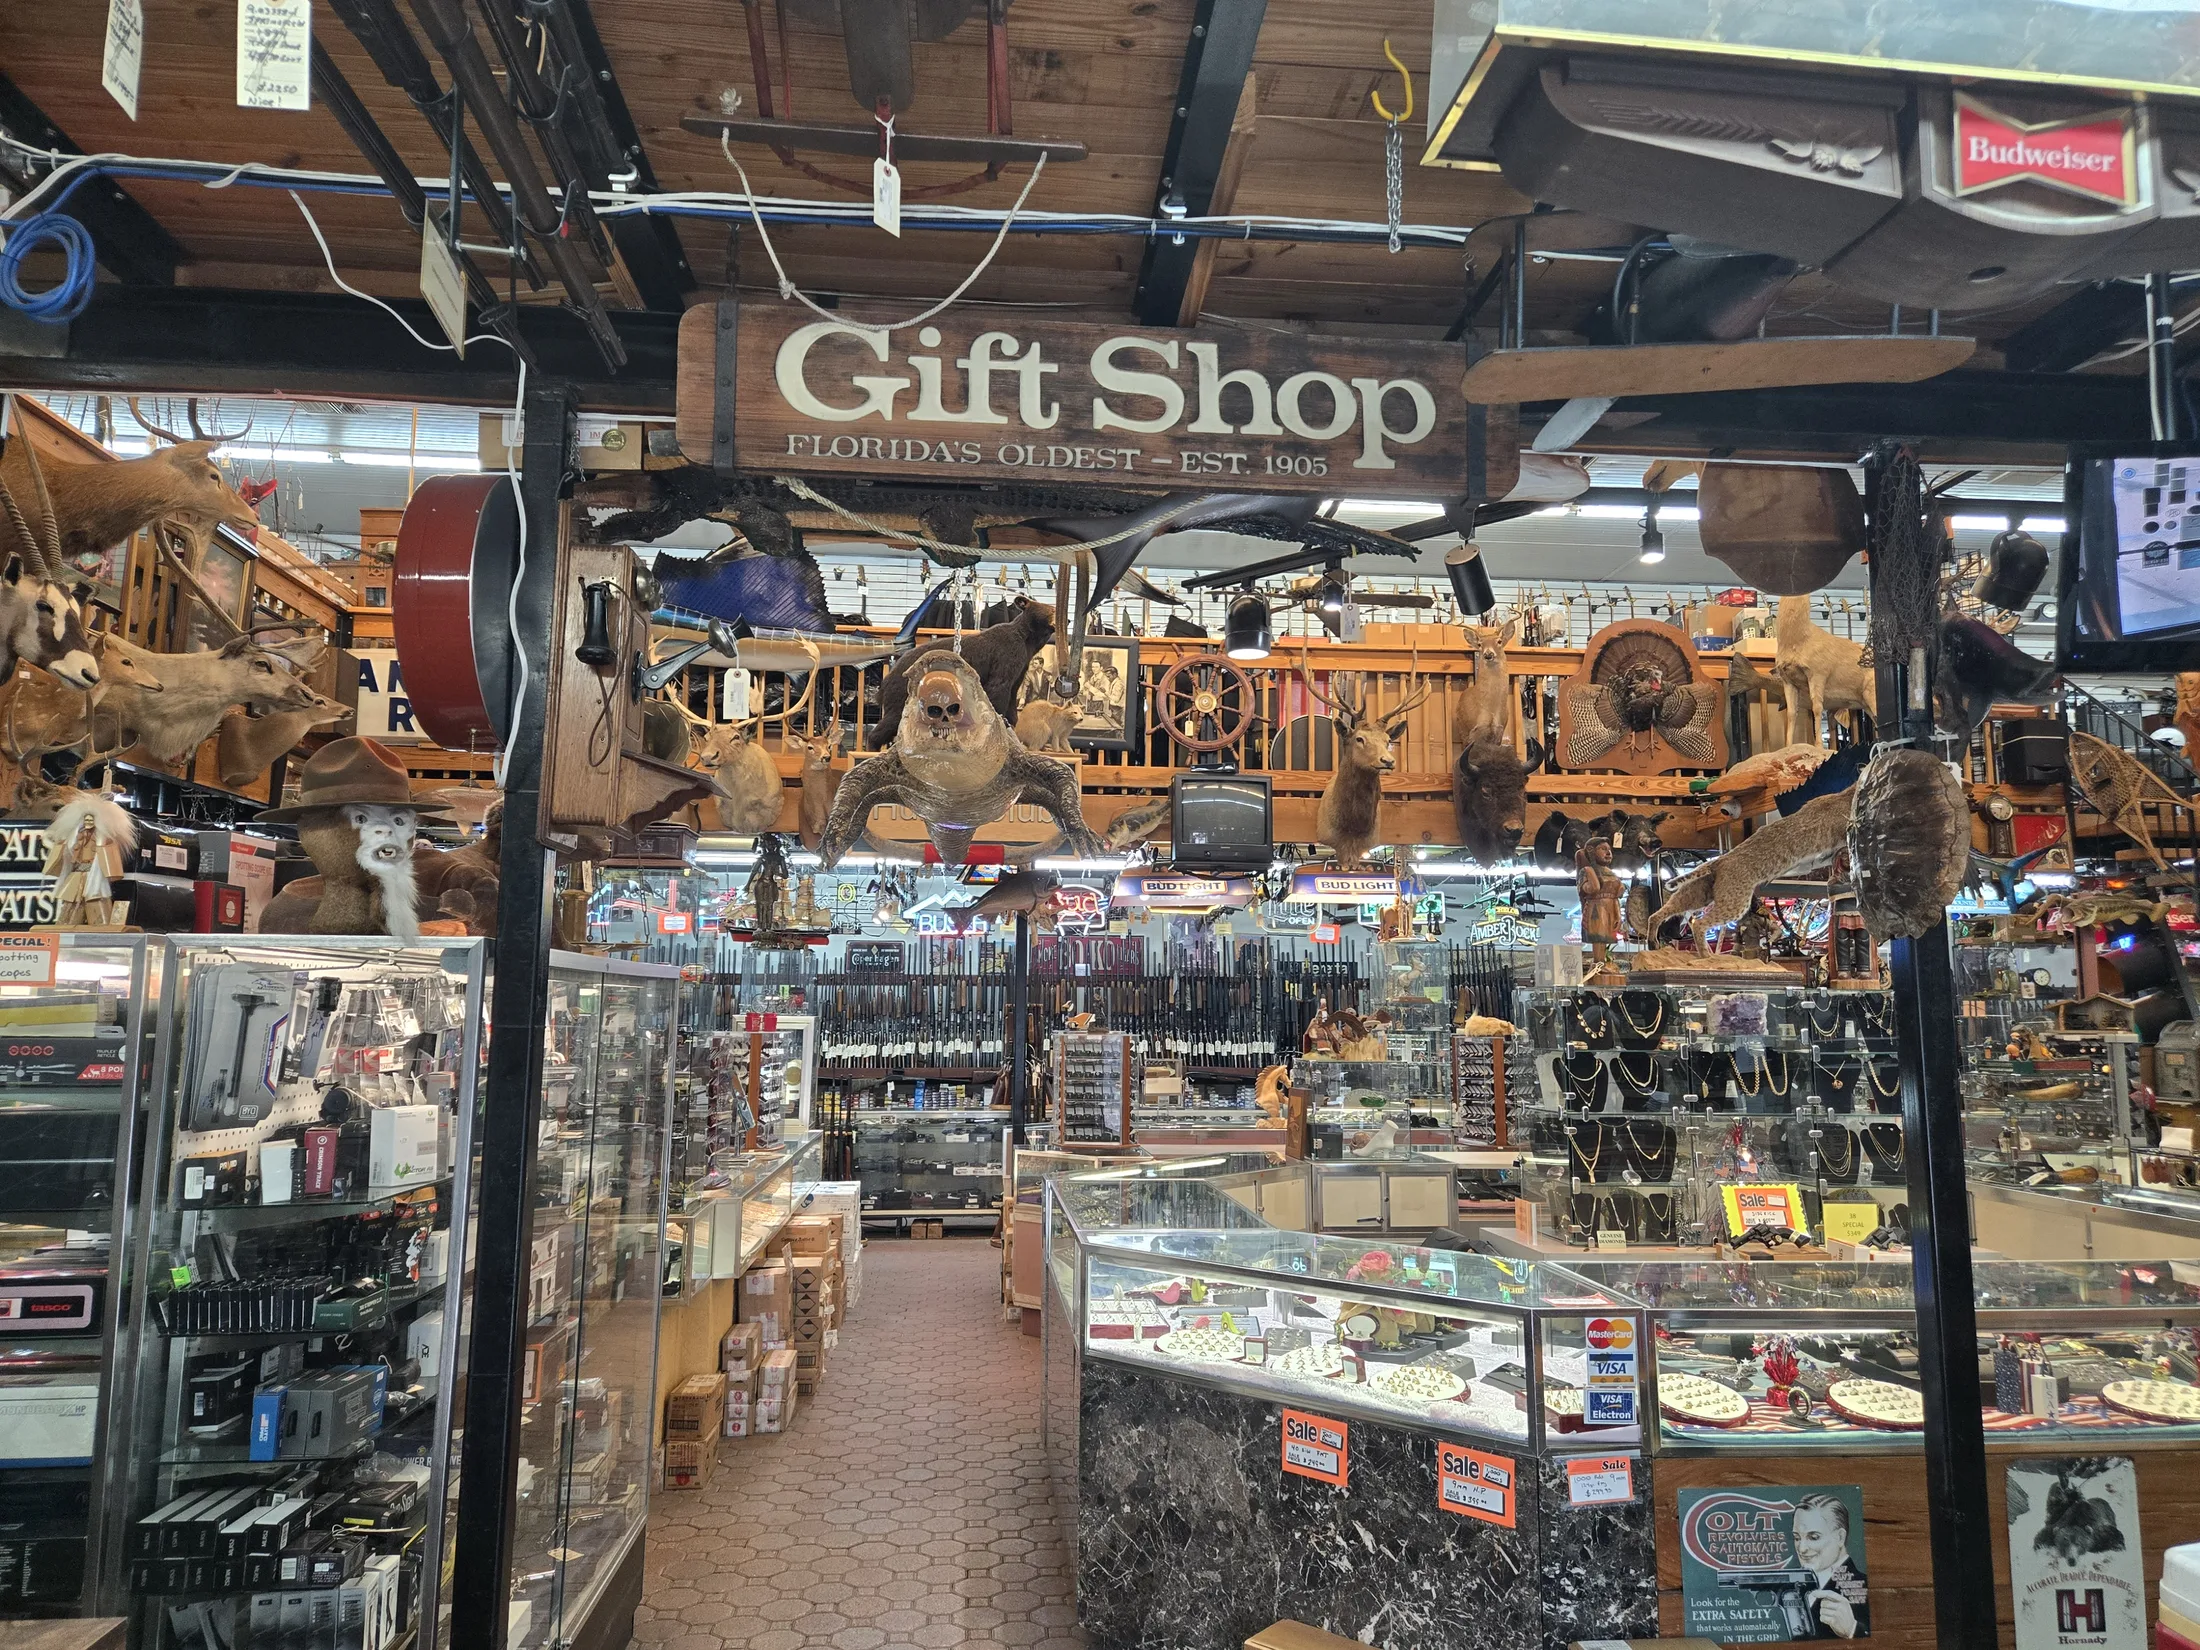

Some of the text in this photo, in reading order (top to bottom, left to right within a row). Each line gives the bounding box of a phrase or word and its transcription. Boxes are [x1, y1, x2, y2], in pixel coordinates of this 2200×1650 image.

[1968, 135, 2116, 172] Budweiser
[775, 321, 1436, 469] Gift Shop
[786, 434, 981, 464] FLORIDA'S
[997, 443, 1141, 471] OLDEST
[1180, 451, 1251, 475] EST.
[1265, 456, 1328, 477] 1905
[164, 836, 183, 846] BSA
[1147, 881, 1222, 891] BUD LIGHT
[1321, 880, 1395, 891] BUD LIGHT
[1288, 917, 1315, 925] OPEN
[1470, 922, 1507, 942] AMBER
[317, 1146, 325, 1171] CRIMSON
[313, 1171, 323, 1189] TRACE
[1739, 1193, 1766, 1207] Sale
[30, 1304, 72, 1312] tasco
[1588, 1330, 1632, 1339] MasterCard
[1597, 1362, 1627, 1375] VISA
[1600, 1394, 1623, 1404] VISA
[75, 1405, 87, 1413] HP
[1592, 1410, 1632, 1419] Electron
[1286, 1417, 1318, 1443] Sale
[1443, 1451, 1480, 1480] Sale
[1601, 1460, 1626, 1470] Sale
[1707, 1531, 1786, 1543] REVOLVERS
[1727, 1553, 1783, 1565] PISTOLS
[1690, 1596, 1740, 1607] Look for the
[1692, 1608, 1772, 1621] EXTRA SAFETY
[2055, 1588, 2107, 1633] H
[1696, 1620, 1781, 1632] that works automatically
[1723, 1633, 1780, 1643] IN THE GRIP
[2057, 1635, 2107, 1645] Hornady
